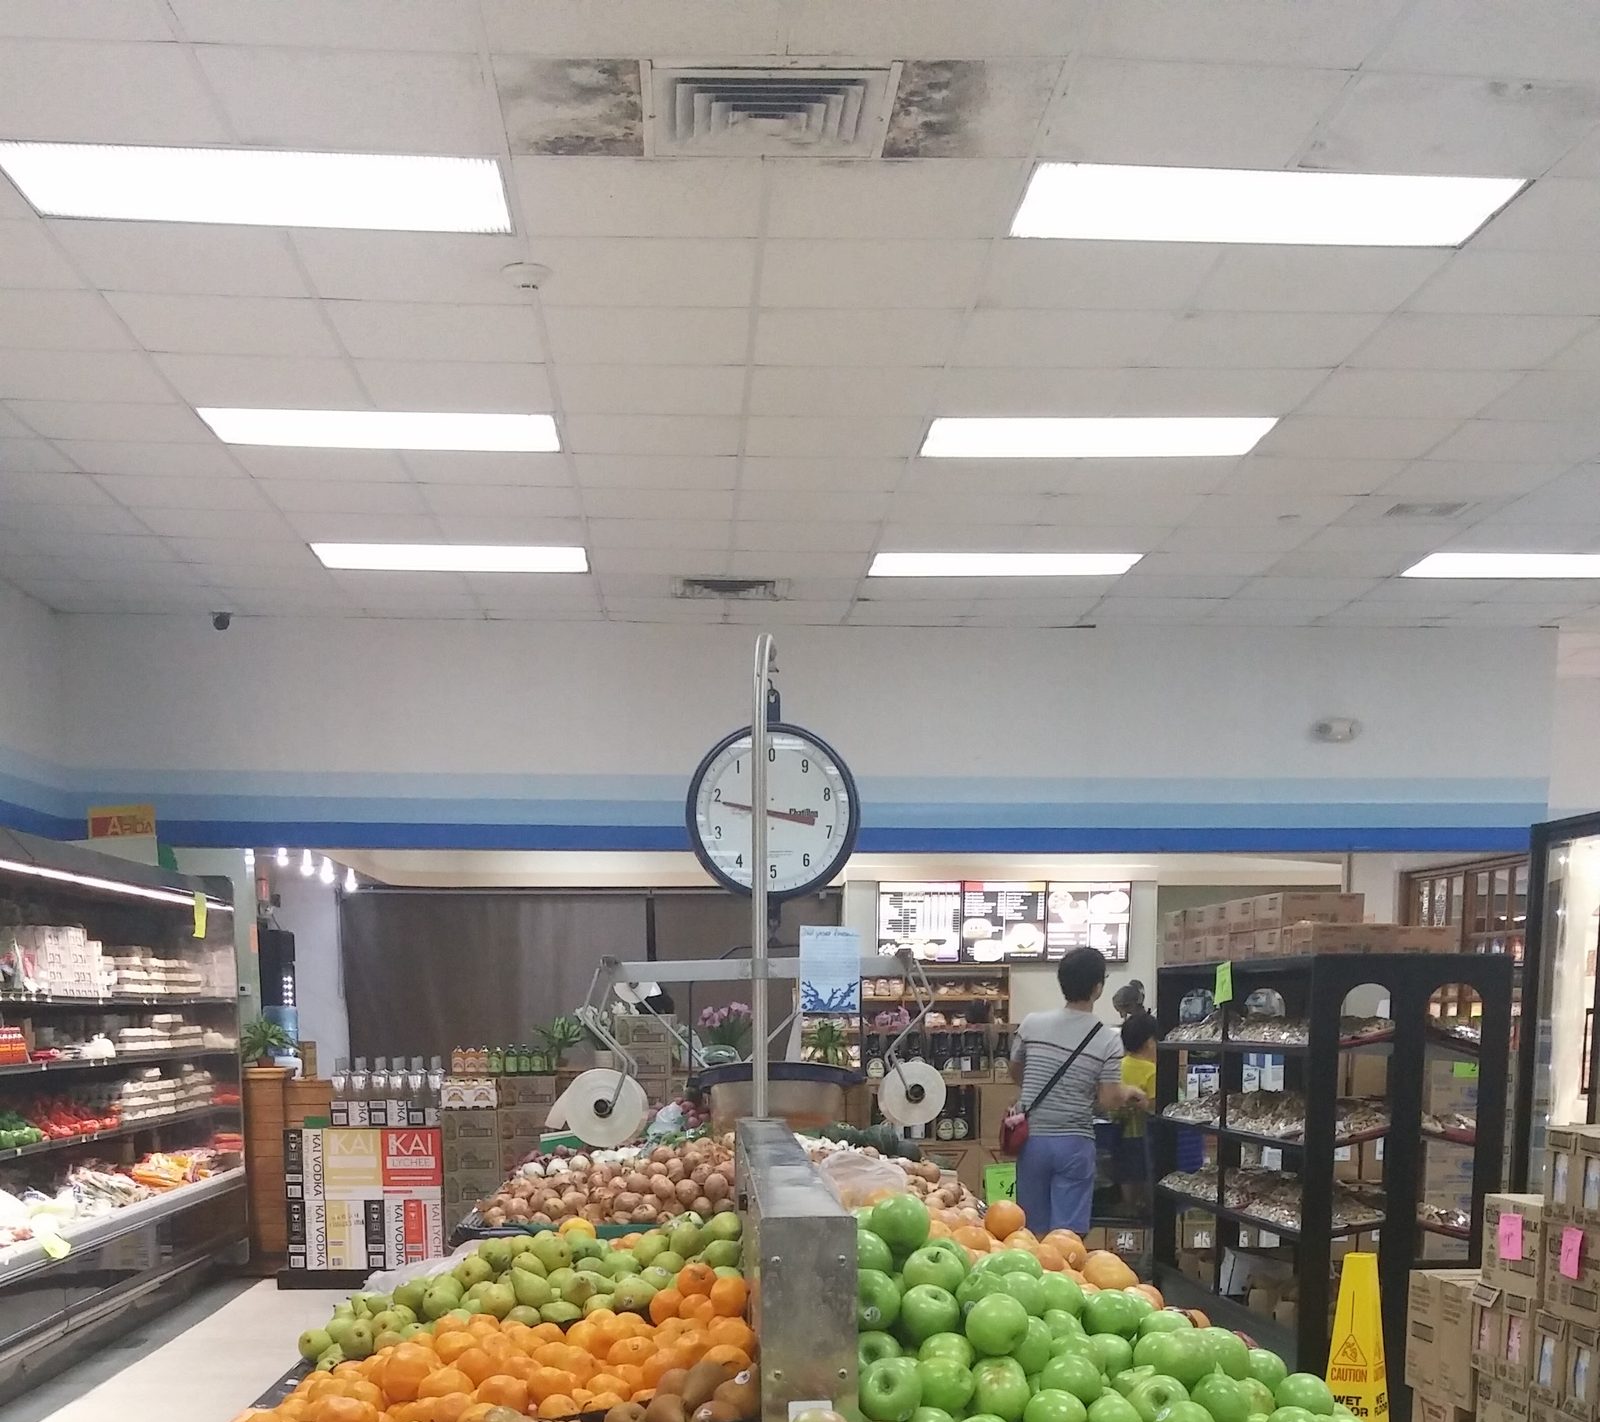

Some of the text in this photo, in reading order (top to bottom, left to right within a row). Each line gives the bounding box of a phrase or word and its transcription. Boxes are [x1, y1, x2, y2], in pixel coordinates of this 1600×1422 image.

[767, 747, 776, 763] 0
[736, 760, 740, 774] 1
[801, 758, 809, 774] 9
[714, 788, 722, 803] 2
[823, 787, 831, 802] 8
[714, 825, 722, 840] 3
[825, 825, 833, 839] 7
[735, 854, 743, 869] 4
[802, 852, 810, 867] 6
[769, 864, 777, 879] 5
[388, 1133, 432, 1156] KAI
[312, 1133, 323, 1197] KAI VODKA
[315, 1204, 326, 1267] KAI VODKA
[394, 1204, 405, 1266] KAI VODKA
[432, 1224, 442, 1259] LYCHE
[1330, 1367, 1368, 1383] CAUTION
[1333, 1394, 1363, 1407] WET
